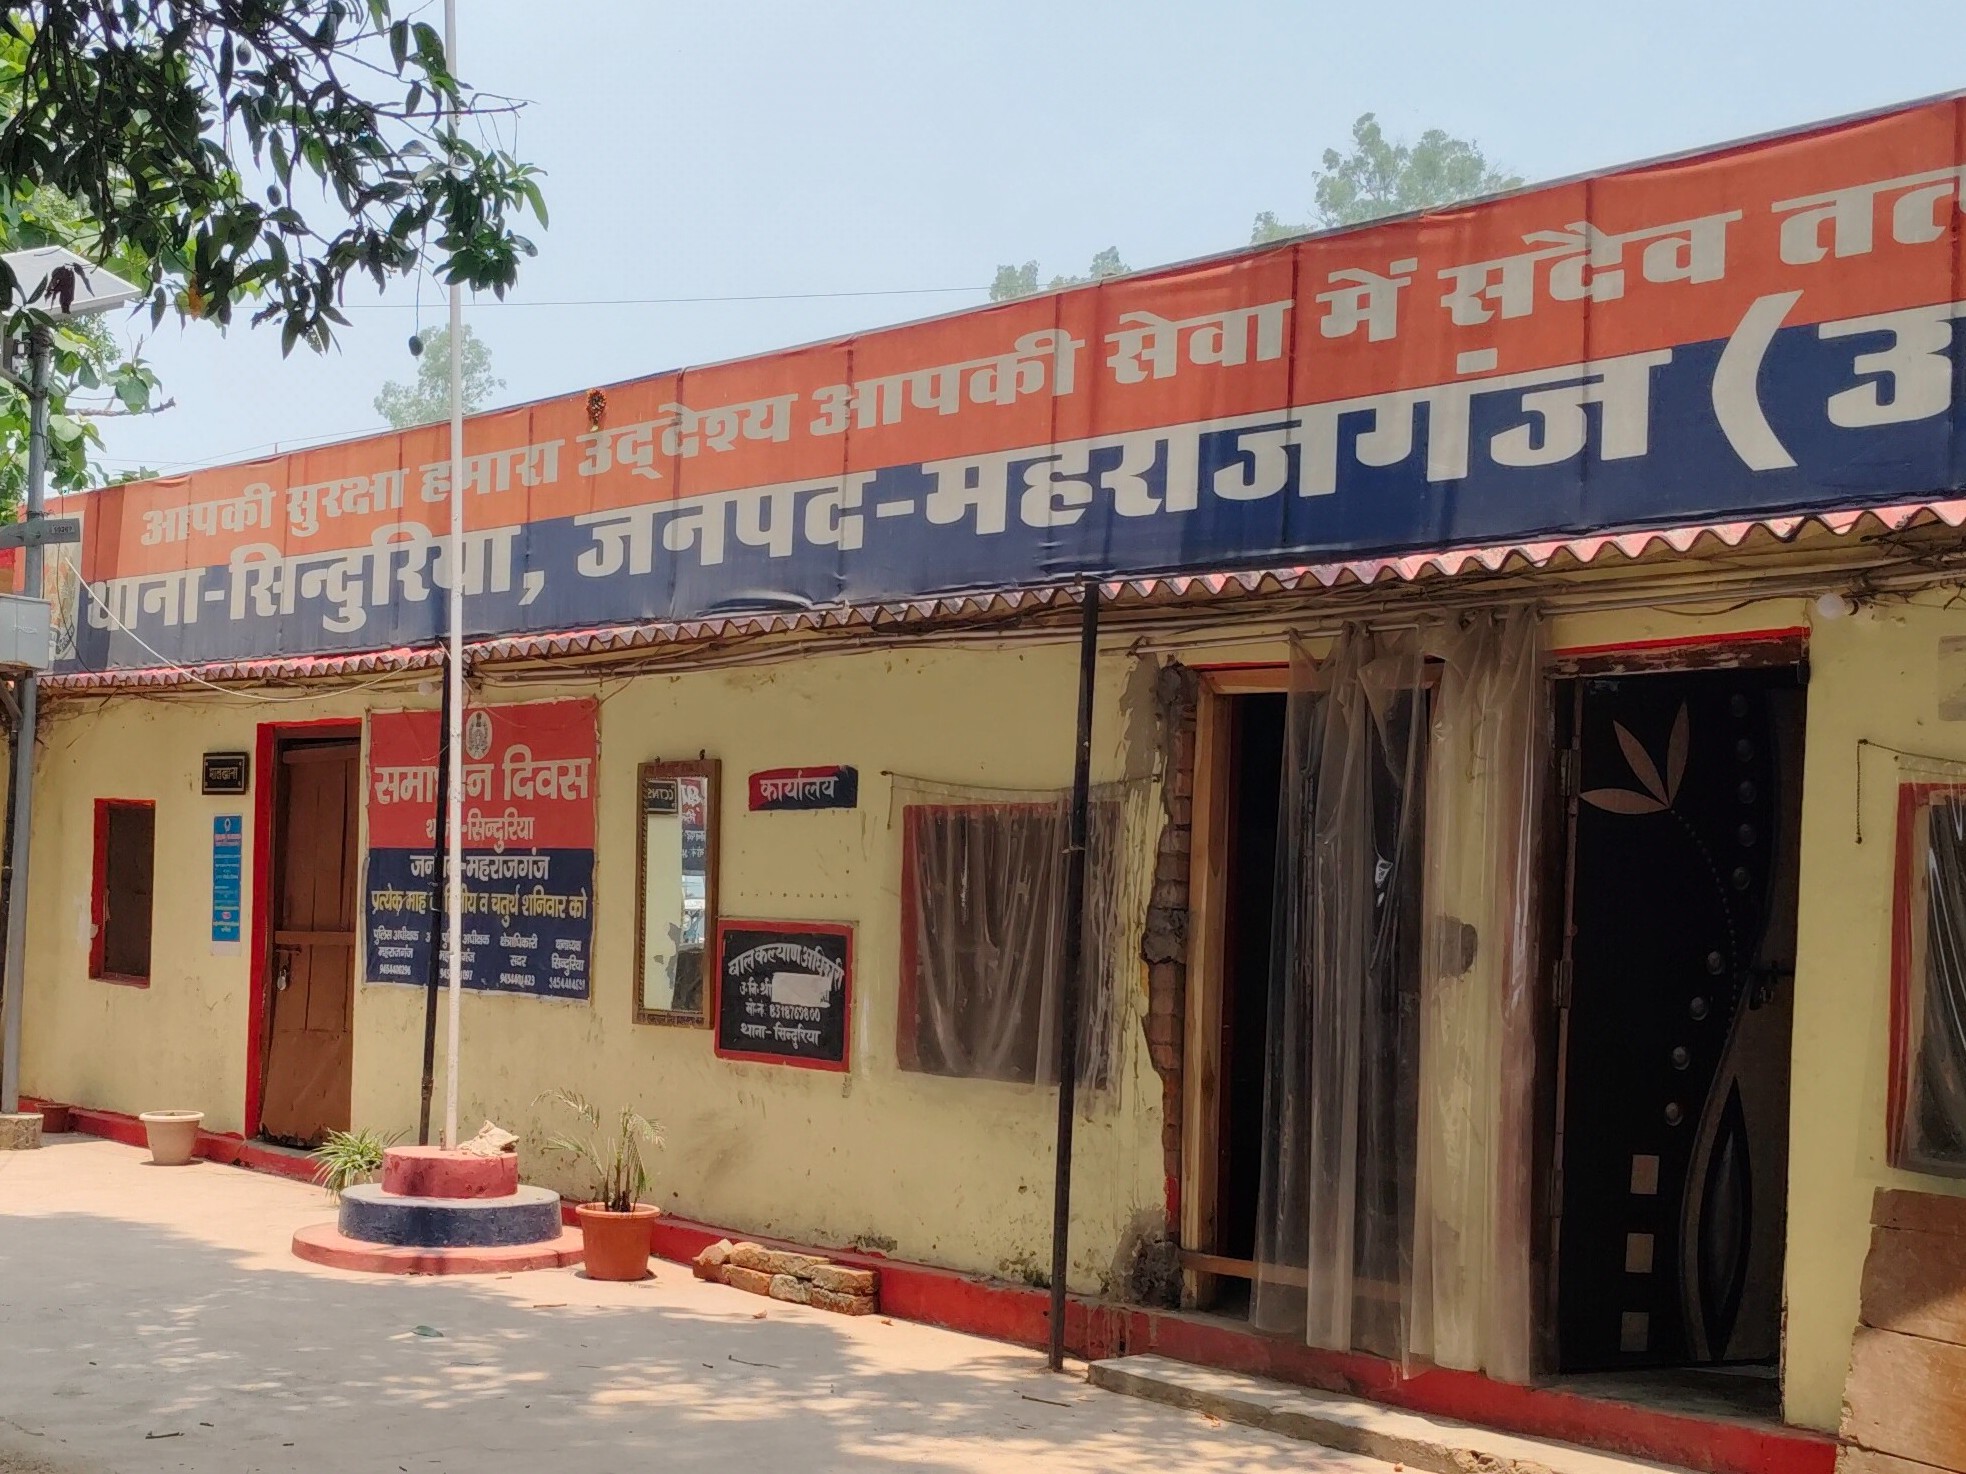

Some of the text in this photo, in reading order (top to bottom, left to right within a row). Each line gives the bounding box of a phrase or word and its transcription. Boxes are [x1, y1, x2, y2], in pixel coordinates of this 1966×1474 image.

[140, 484, 275, 546] आपकी
[286, 467, 409, 537] सुरक्षा
[419, 438, 564, 503] हमारा
[810, 328, 1086, 438] आपकी
[1104, 300, 1294, 385] सेवा
[1316, 257, 1419, 342] में
[1437, 209, 1743, 328] सदैव
[1771, 164, 1966, 266] तत्
[502, 744, 592, 801] दिवस
[760, 770, 839, 802] कार्यालय
[405, 890, 427, 914] माह
[479, 892, 490, 915] व
[491, 884, 520, 928] चतुर्थ
[522, 887, 568, 920] शनिवार
[568, 888, 588, 919] को
[509, 955, 527, 967] सदर
[754, 943, 802, 966] कल्याण
